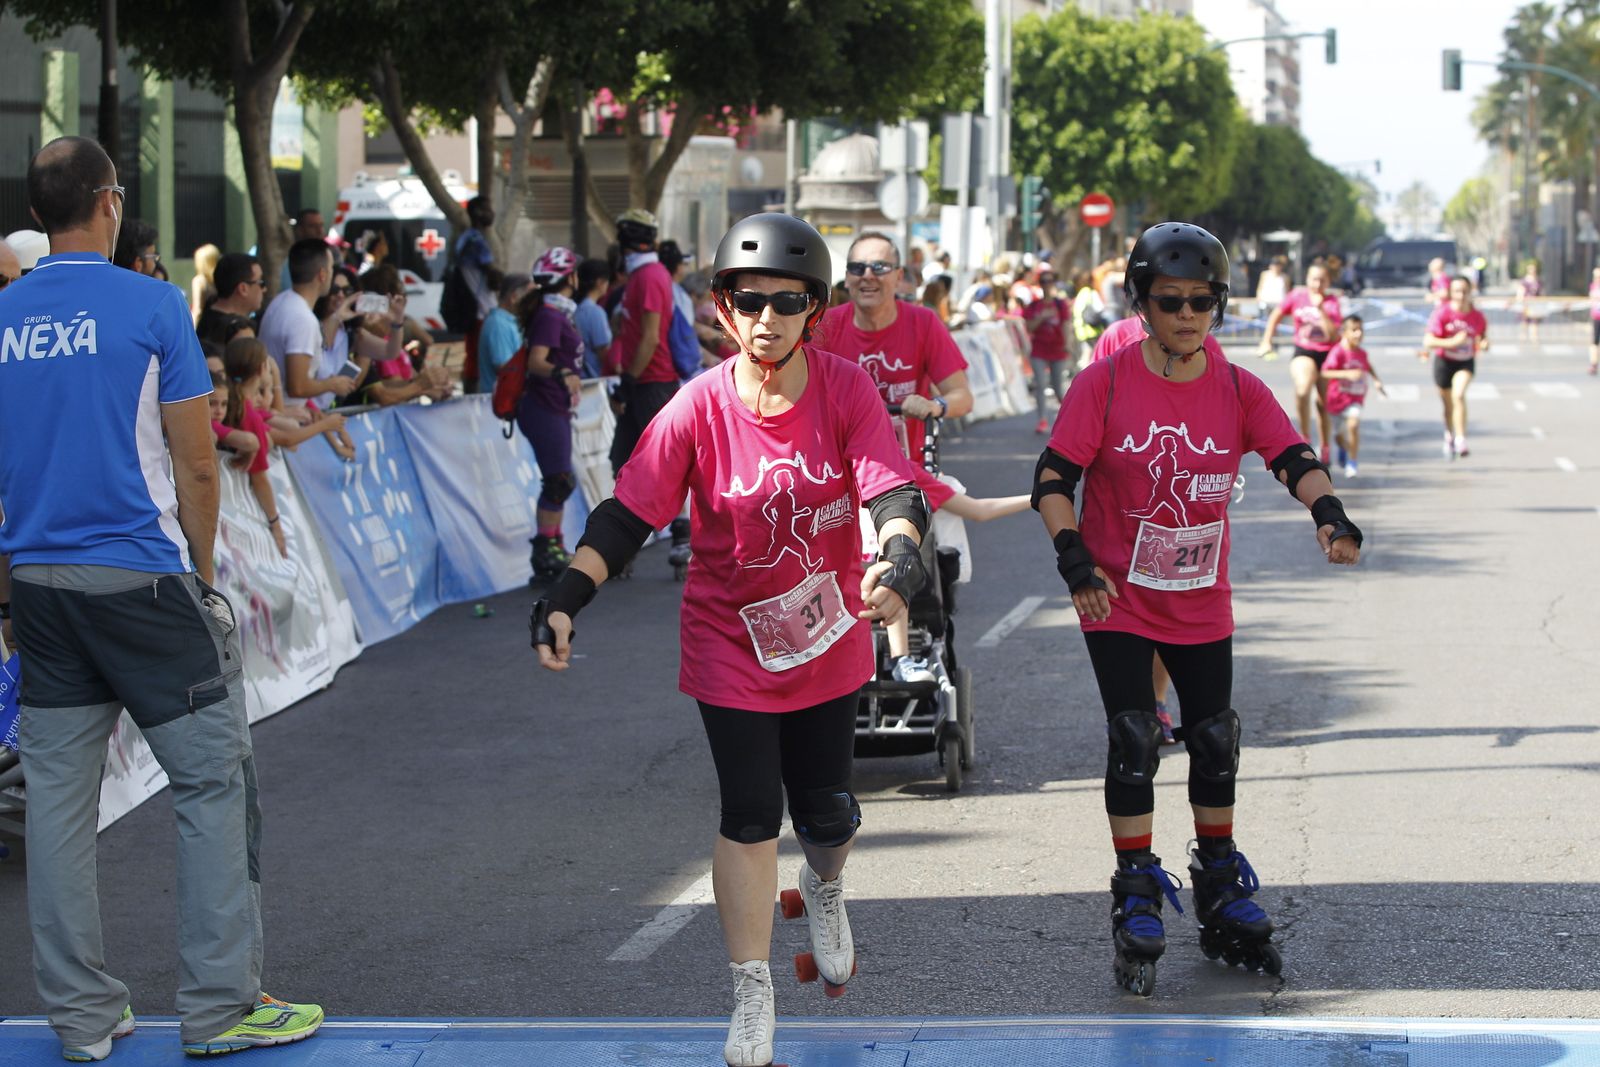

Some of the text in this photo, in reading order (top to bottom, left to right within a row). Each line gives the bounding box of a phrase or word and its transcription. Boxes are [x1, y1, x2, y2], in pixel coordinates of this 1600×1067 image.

[24, 314, 52, 324] GRUPO
[1185, 474, 1199, 501] 4
[809, 508, 820, 538] 4
[1173, 543, 1213, 567] 217
[800, 593, 825, 629] 37
